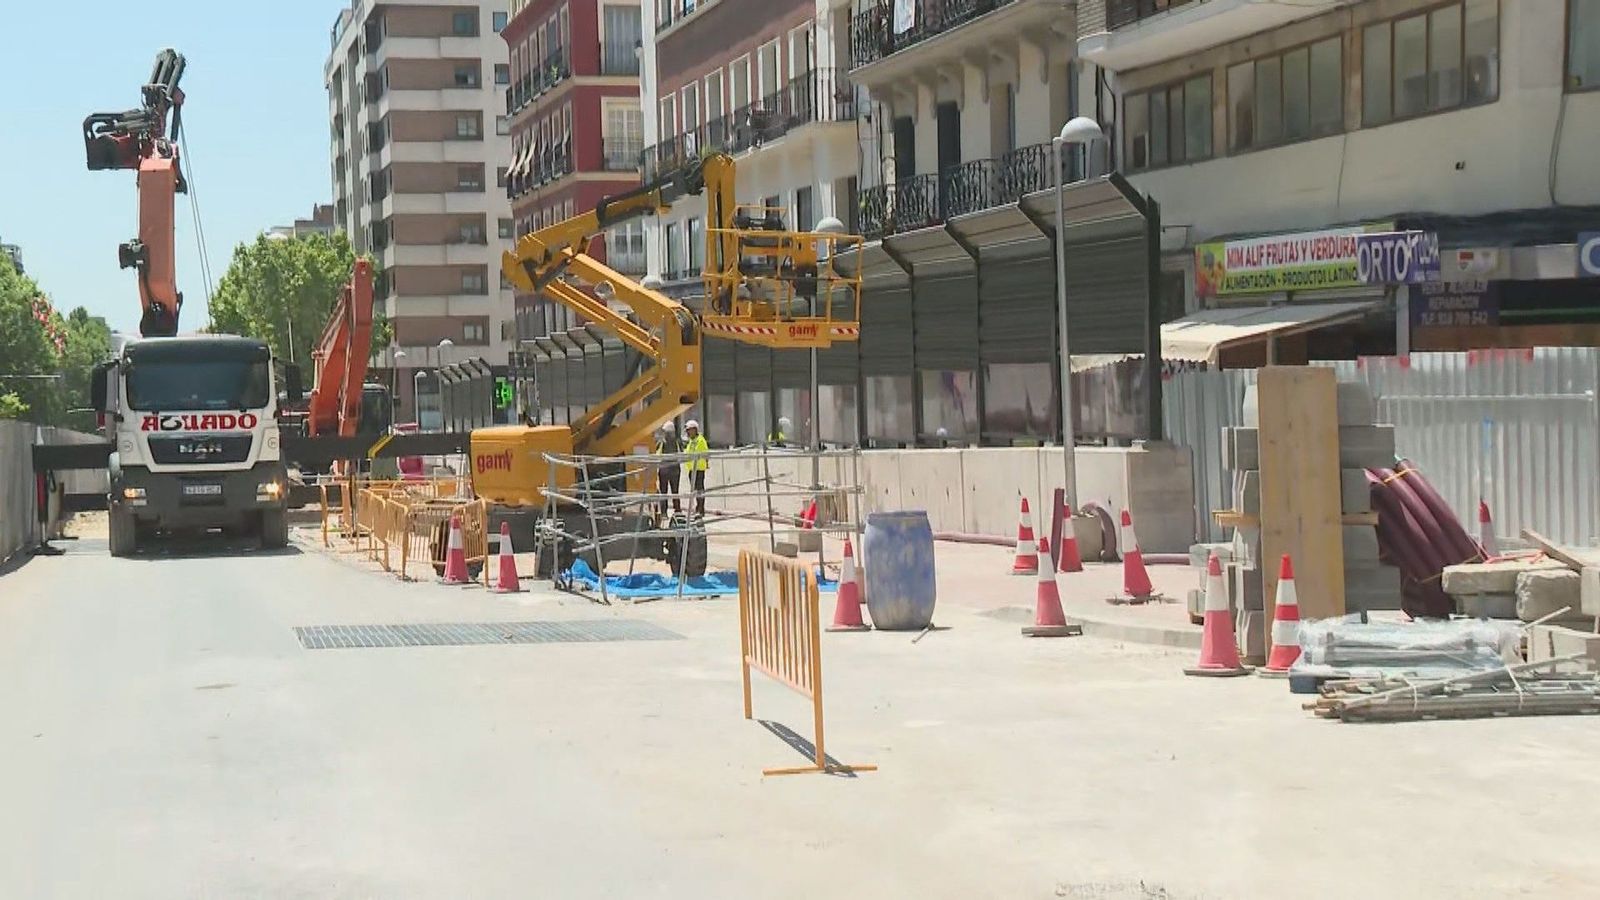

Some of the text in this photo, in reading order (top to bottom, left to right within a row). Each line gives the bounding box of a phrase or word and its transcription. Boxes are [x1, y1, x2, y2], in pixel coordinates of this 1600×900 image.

[1266, 240, 1299, 265] FRUTAS
[1301, 239, 1308, 261] Y
[179, 443, 223, 453] MAN
